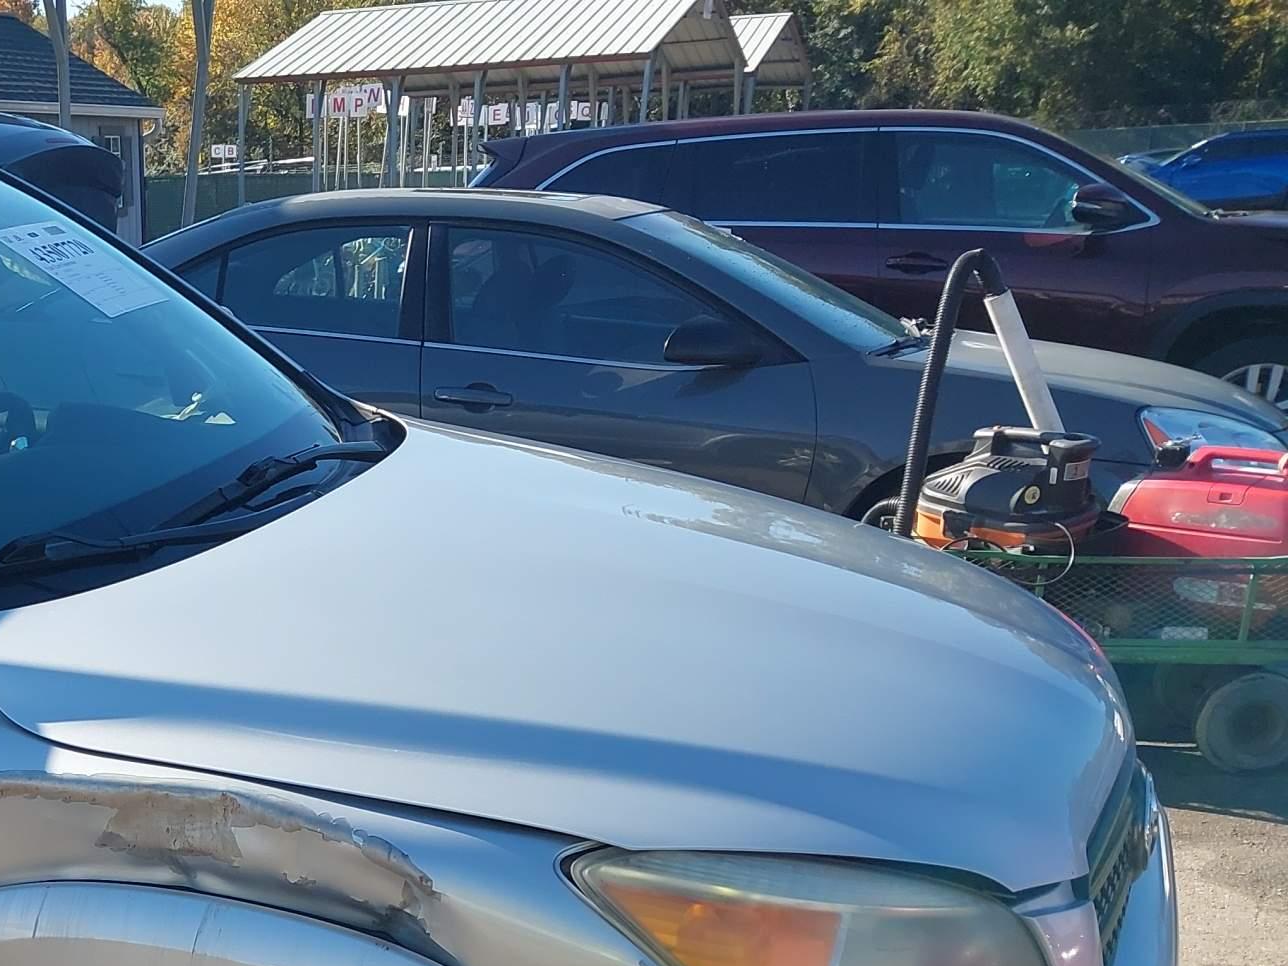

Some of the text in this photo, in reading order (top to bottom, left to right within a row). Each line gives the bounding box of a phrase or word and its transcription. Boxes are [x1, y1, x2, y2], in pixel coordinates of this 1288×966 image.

[333, 97, 346, 113] M
[354, 97, 364, 113] P
[492, 108, 502, 122] E
[214, 146, 221, 156] C
[28, 239, 96, 264] 43507720
